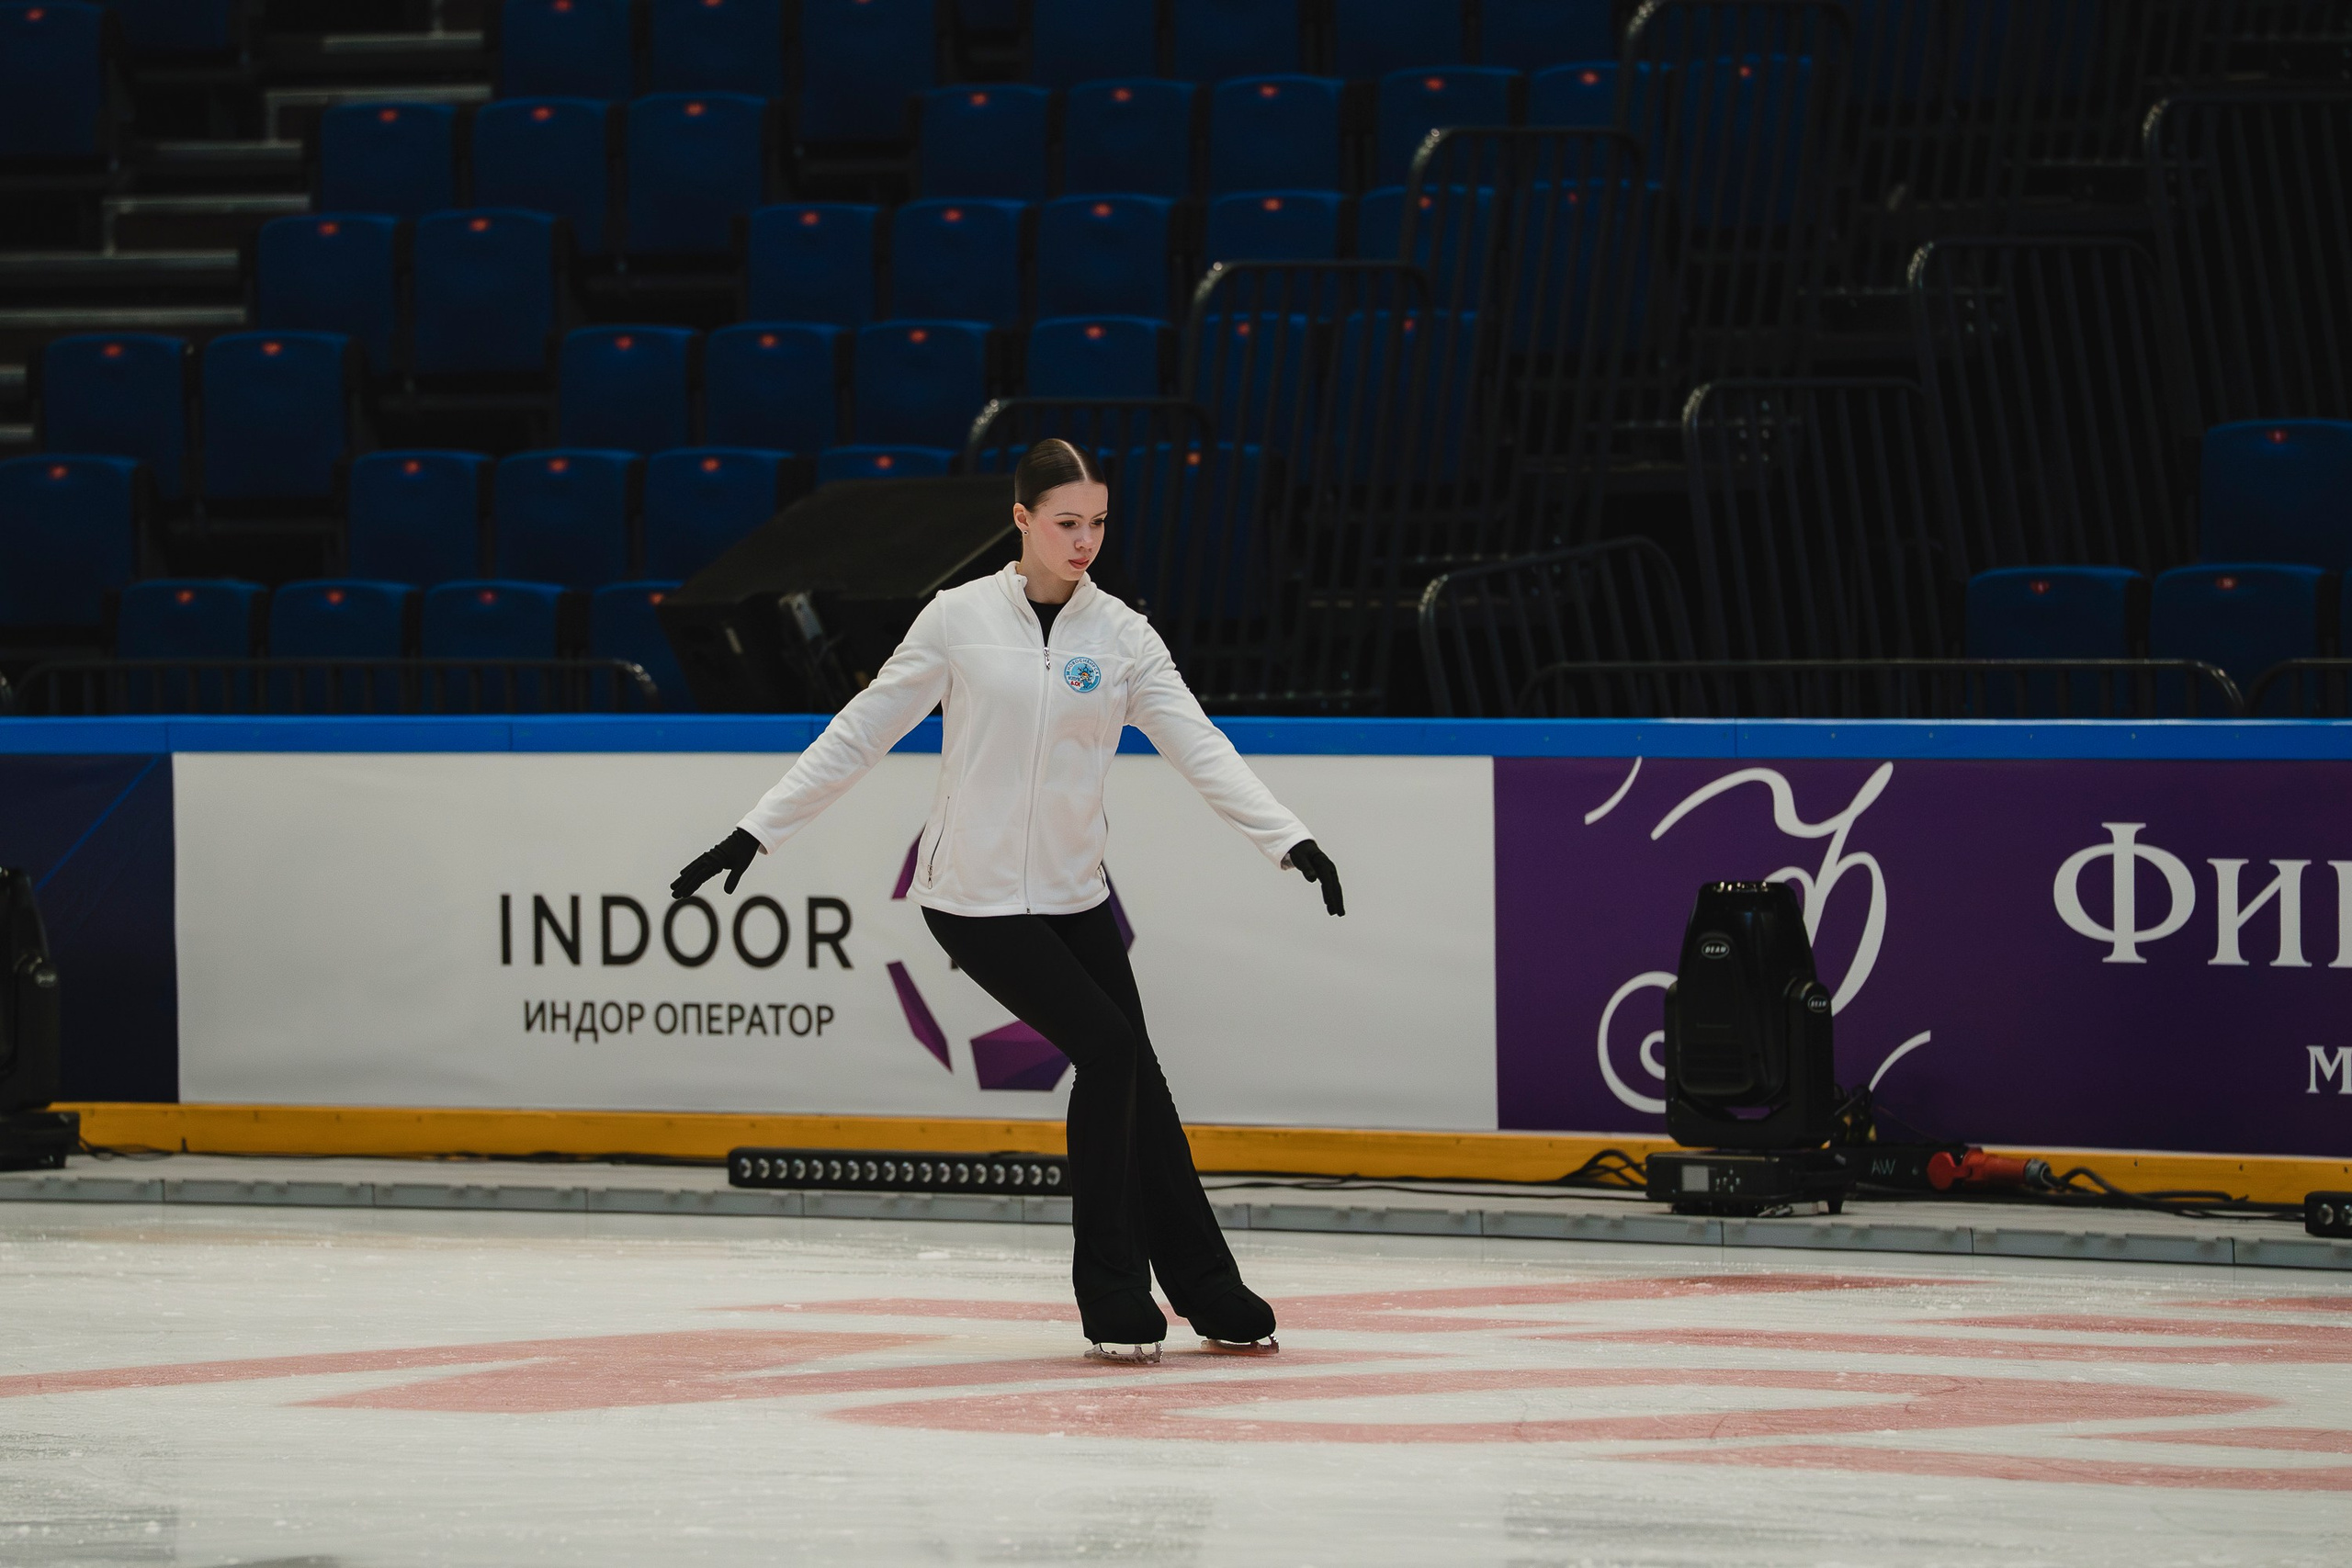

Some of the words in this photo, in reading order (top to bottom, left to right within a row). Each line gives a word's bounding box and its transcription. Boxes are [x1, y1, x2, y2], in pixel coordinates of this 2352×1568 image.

[501, 895, 854, 969] INDOOR
[2053, 822, 2352, 968] Фи
[525, 1000, 644, 1043] ИНДОР
[654, 1002, 834, 1037] ОПЕРАТОР
